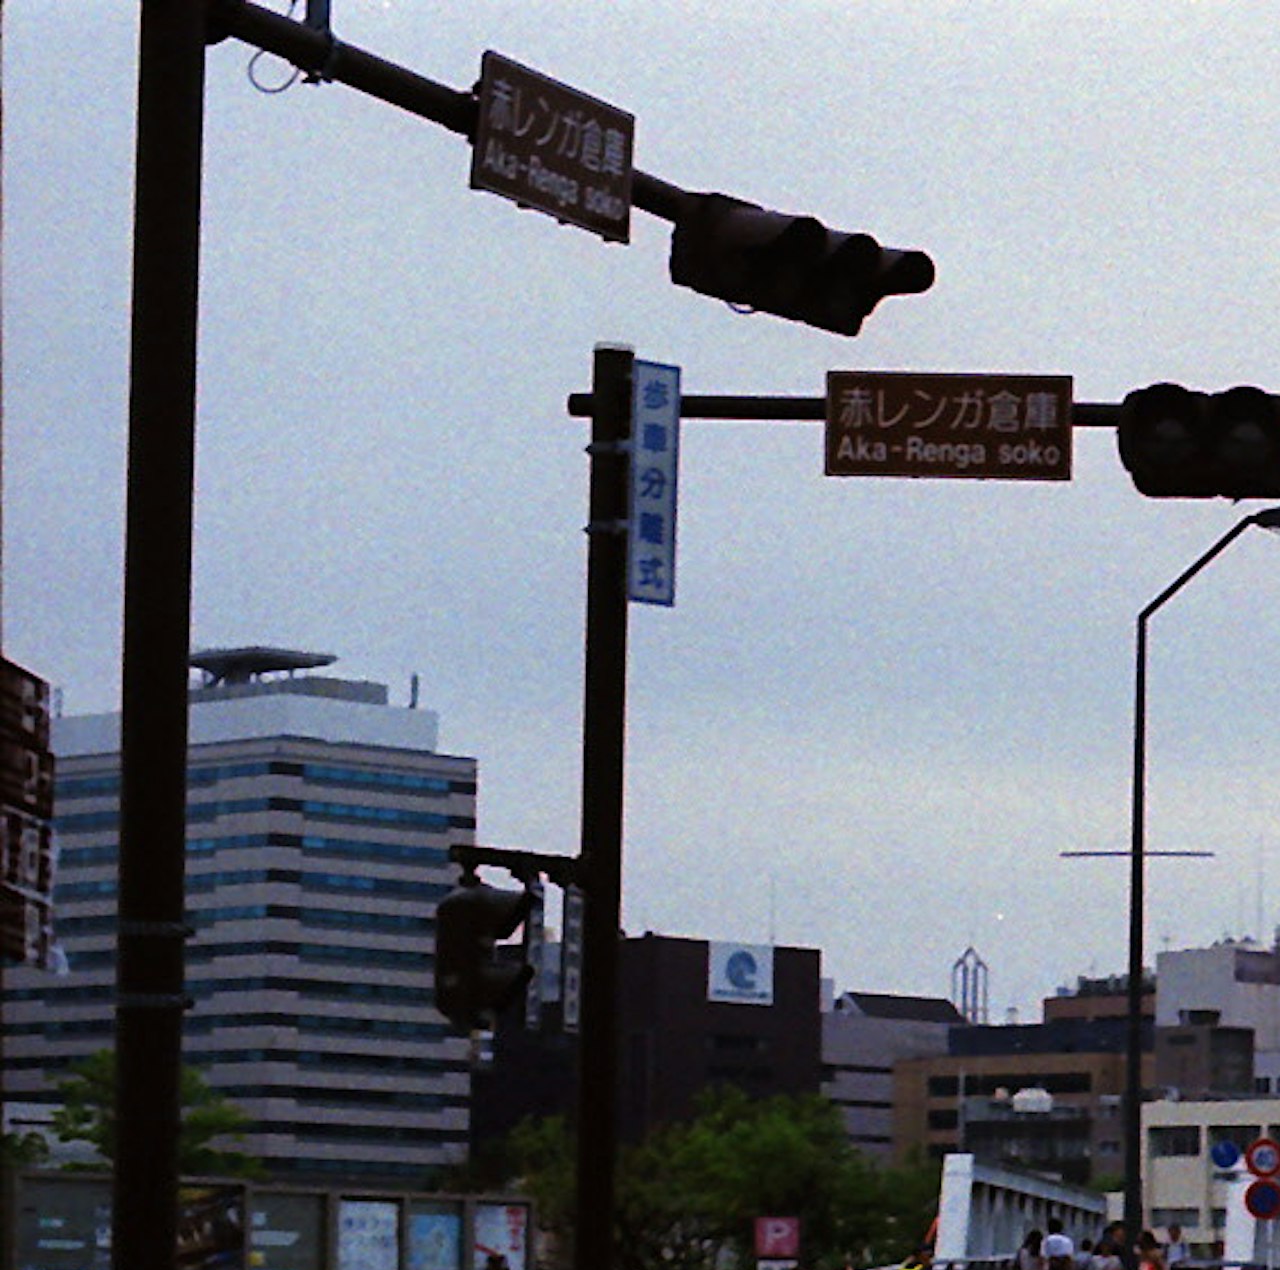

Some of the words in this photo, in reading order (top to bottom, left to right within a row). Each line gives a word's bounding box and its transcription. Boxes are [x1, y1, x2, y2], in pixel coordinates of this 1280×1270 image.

[488, 79, 626, 177] 赤レンガ倉庫
[482, 137, 580, 207] Aka-Renga
[839, 386, 1060, 433] 赤レンガ倉庫
[837, 434, 986, 469] Aka-Renga
[1000, 440, 1061, 466] soko
[764, 1221, 791, 1250] P
